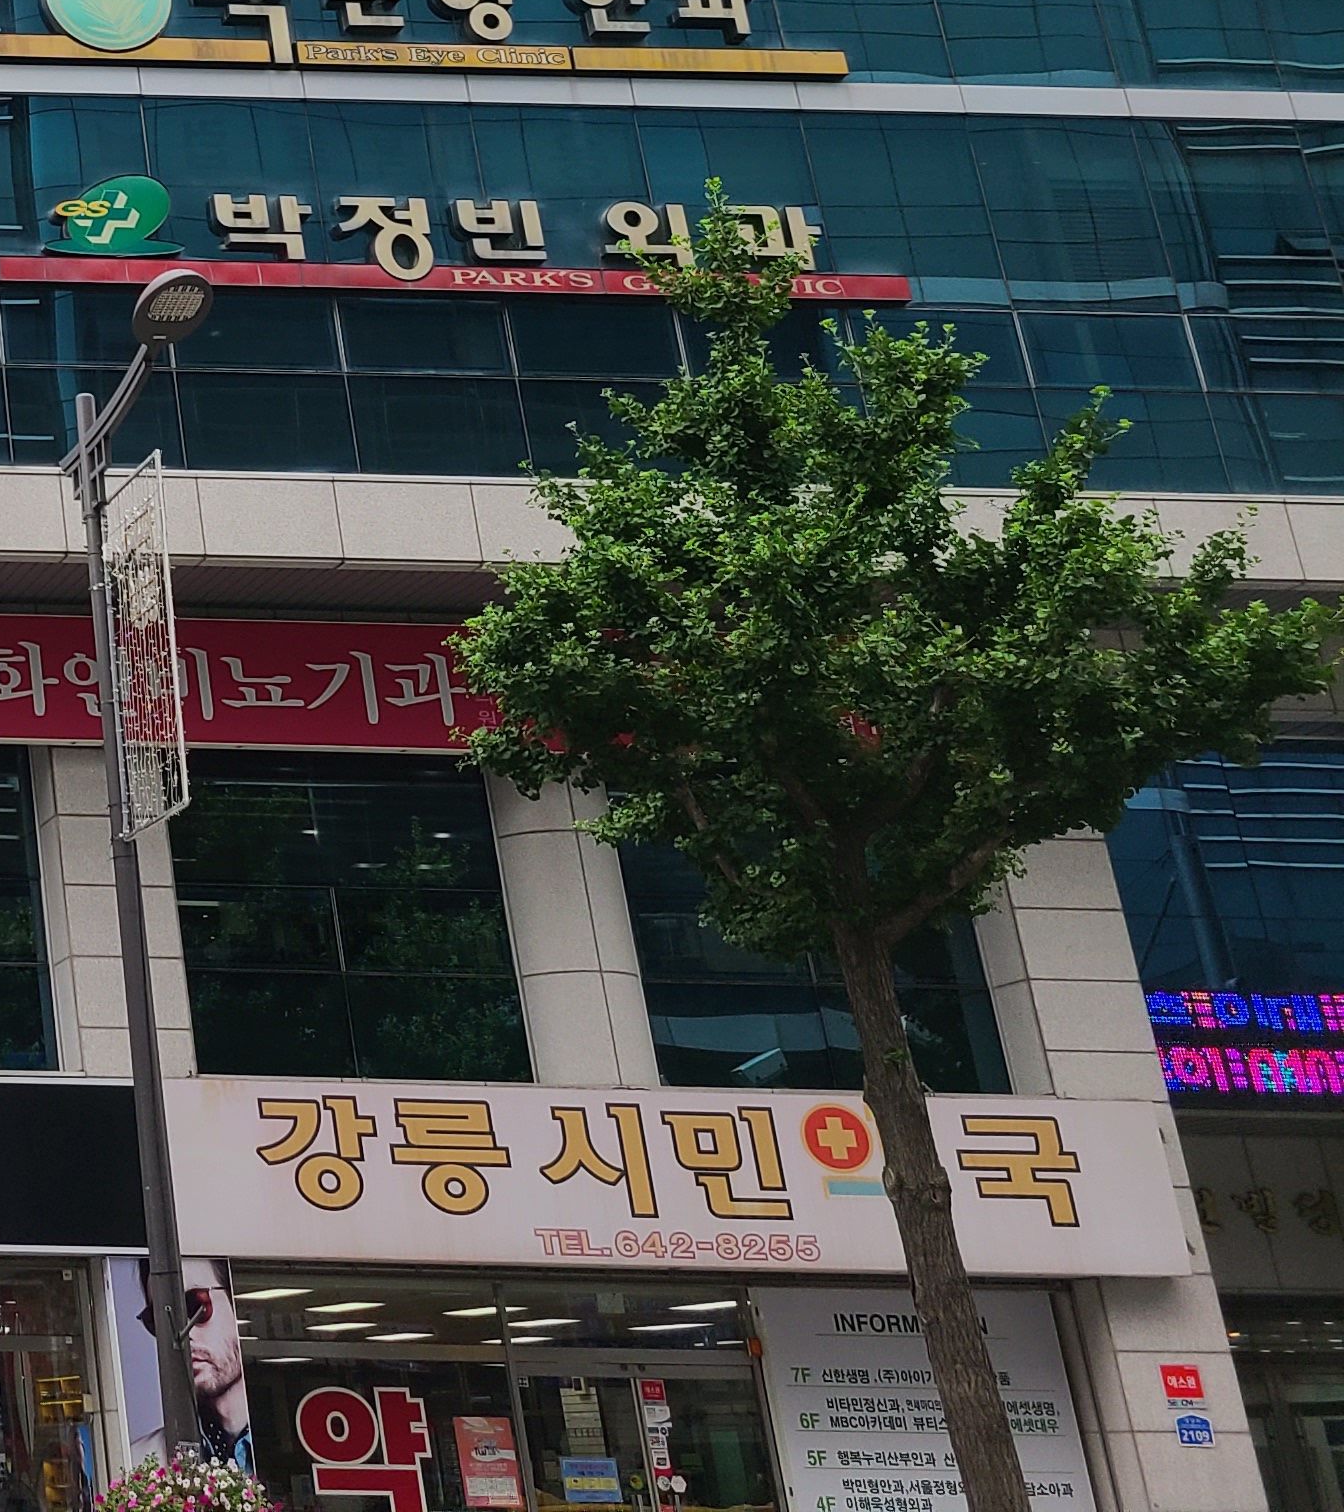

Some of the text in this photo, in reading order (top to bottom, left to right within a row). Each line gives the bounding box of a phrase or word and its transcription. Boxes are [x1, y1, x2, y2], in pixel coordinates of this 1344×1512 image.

[304, 41, 567, 68] Park's Eye Clinic
[210, 191, 546, 281] 박정빈
[450, 269, 594, 289] PARK'S
[790, 1366, 812, 1384] 7F
[821, 1368, 871, 1385] 신한생명
[799, 1412, 821, 1430] 6F
[1180, 1429, 1210, 1442] 2109
[806, 1449, 827, 1467] 5F
[836, 1450, 937, 1468] 행복누리산부인과
